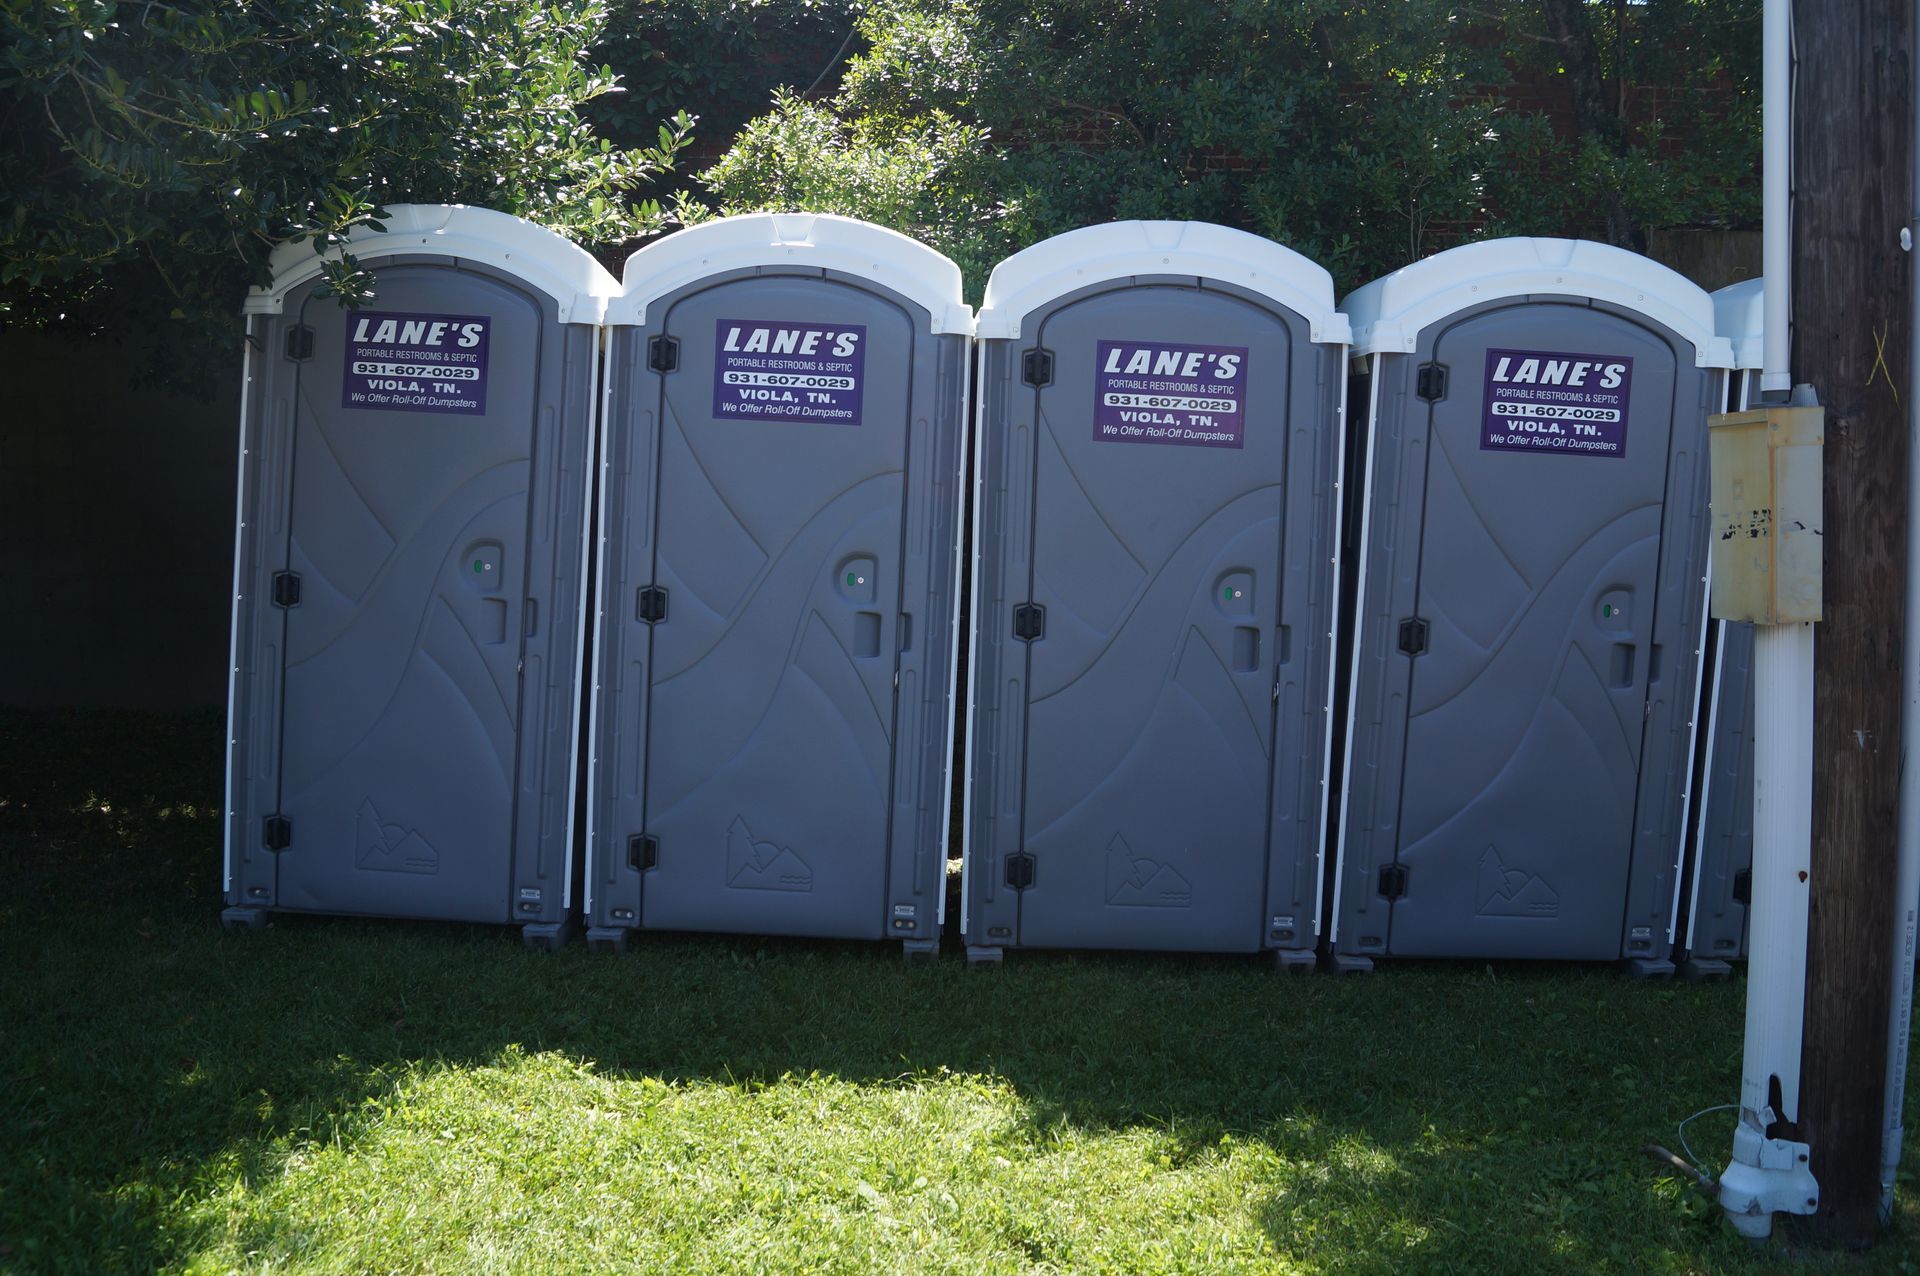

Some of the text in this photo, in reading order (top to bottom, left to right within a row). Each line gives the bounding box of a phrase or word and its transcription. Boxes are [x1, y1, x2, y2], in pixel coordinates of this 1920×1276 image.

[353, 319, 483, 348] LANE'S
[723, 328, 859, 357] LANE'S
[357, 348, 477, 362] PORTABLE RESTROOMS & SEPTIC
[357, 364, 475, 378] 931-607-0029
[728, 358, 852, 372] PORTABLE RESTROOMS & SEPTIC
[1104, 349, 1241, 379] LANE'S
[728, 374, 850, 388] 931-607-0029
[1493, 358, 1626, 389] LANE'S
[368, 379, 461, 393] VIOLA, TN.
[1109, 379, 1234, 395] PORTABLE RESTROOMS & SEPTIC
[352, 393, 477, 408] We Offer Roll-Off Dumpsters
[739, 389, 836, 404] VIOLA, TN.
[1109, 396, 1232, 410] 931-607-0029
[1497, 388, 1618, 404] PORTABLE RESTROOMS & SEPTIC
[722, 402, 853, 418] We Offer Roll-Off Dumpsters
[1497, 404, 1615, 420] 931-607-0029
[1120, 411, 1218, 427] VIOLA, TN.
[1103, 425, 1234, 441] We Offer Roll-Off Dumpsters
[1507, 420, 1601, 436] VIOLA, TN.
[1491, 434, 1617, 450] We Offer Roll-Off Dumpsters
